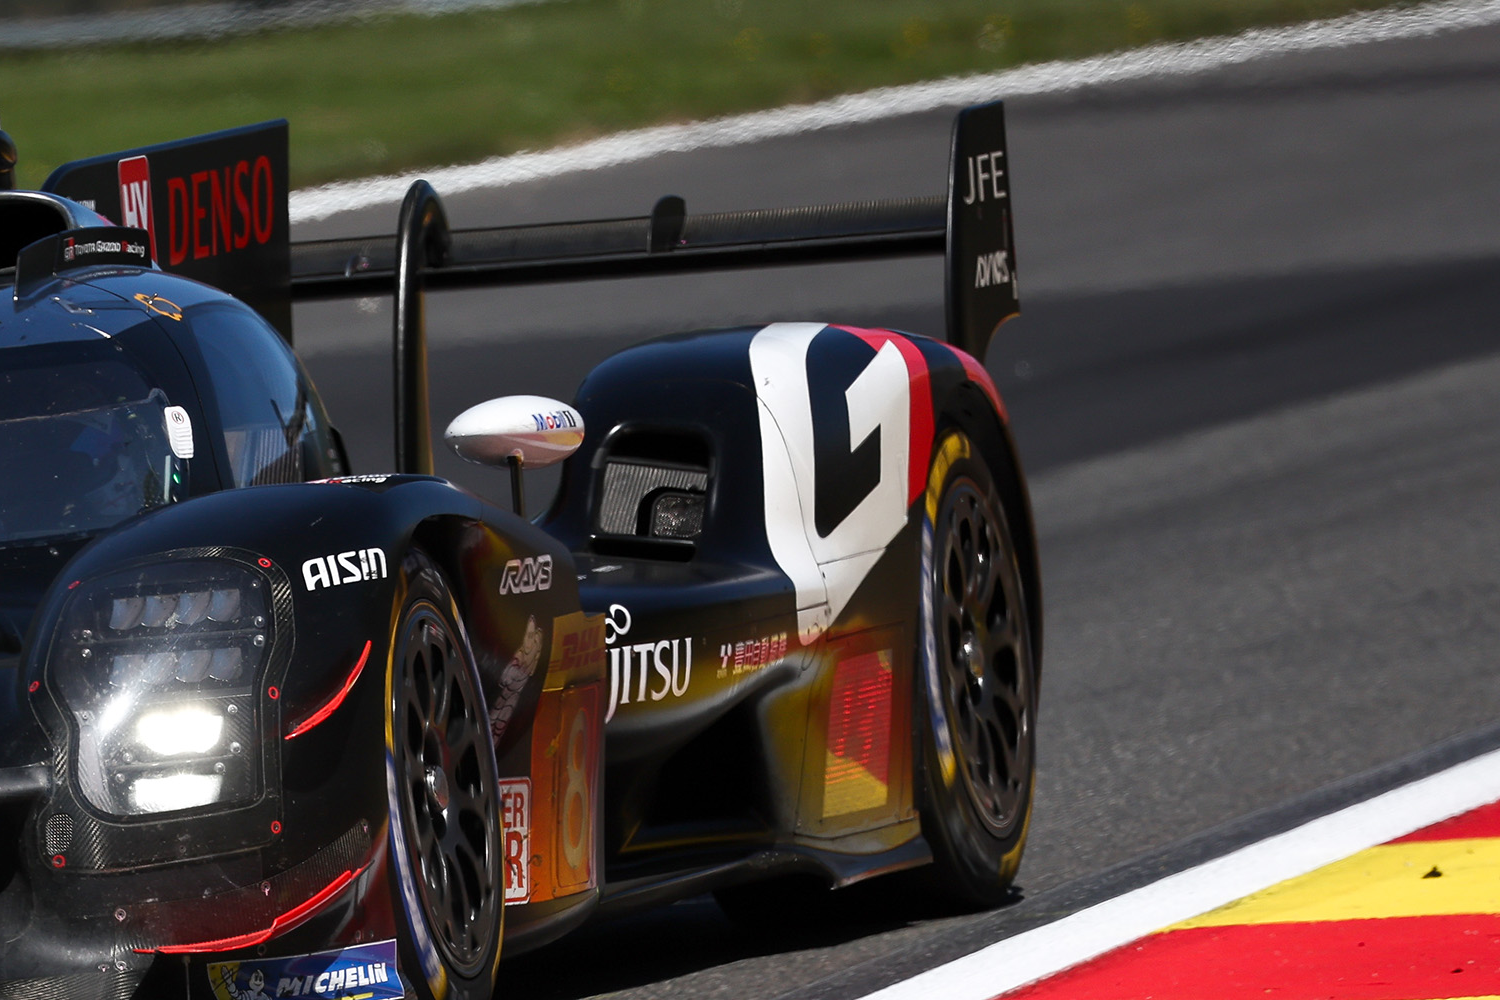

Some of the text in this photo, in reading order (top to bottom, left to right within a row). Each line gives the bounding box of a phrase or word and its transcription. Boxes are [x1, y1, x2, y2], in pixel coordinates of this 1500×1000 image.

[963, 151, 1007, 205] JFE
[122, 180, 149, 230] HY
[167, 155, 274, 266] DENSO
[532, 410, 577, 431] Mobil 1
[302, 546, 388, 591] AISIN
[499, 554, 553, 595] RAYS
[605, 636, 693, 724] JITSU
[562, 707, 589, 870] 8
[276, 962, 389, 998] MICHELIN
